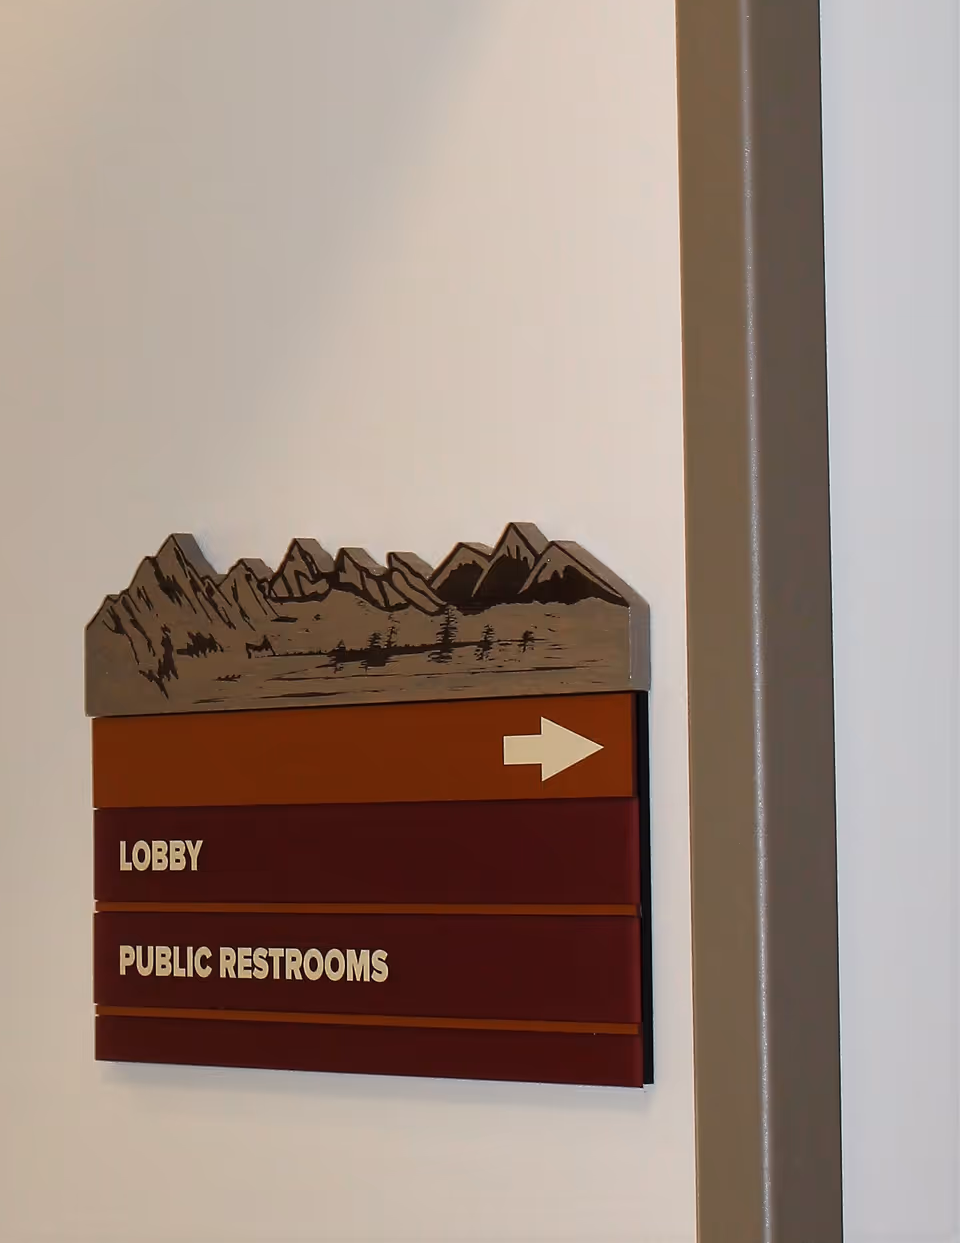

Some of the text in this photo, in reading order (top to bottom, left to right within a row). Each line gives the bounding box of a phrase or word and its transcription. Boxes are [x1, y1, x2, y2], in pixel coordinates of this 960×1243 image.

[119, 840, 203, 871] LOBBY
[119, 945, 389, 983] PUBLIC RESTROOMS
